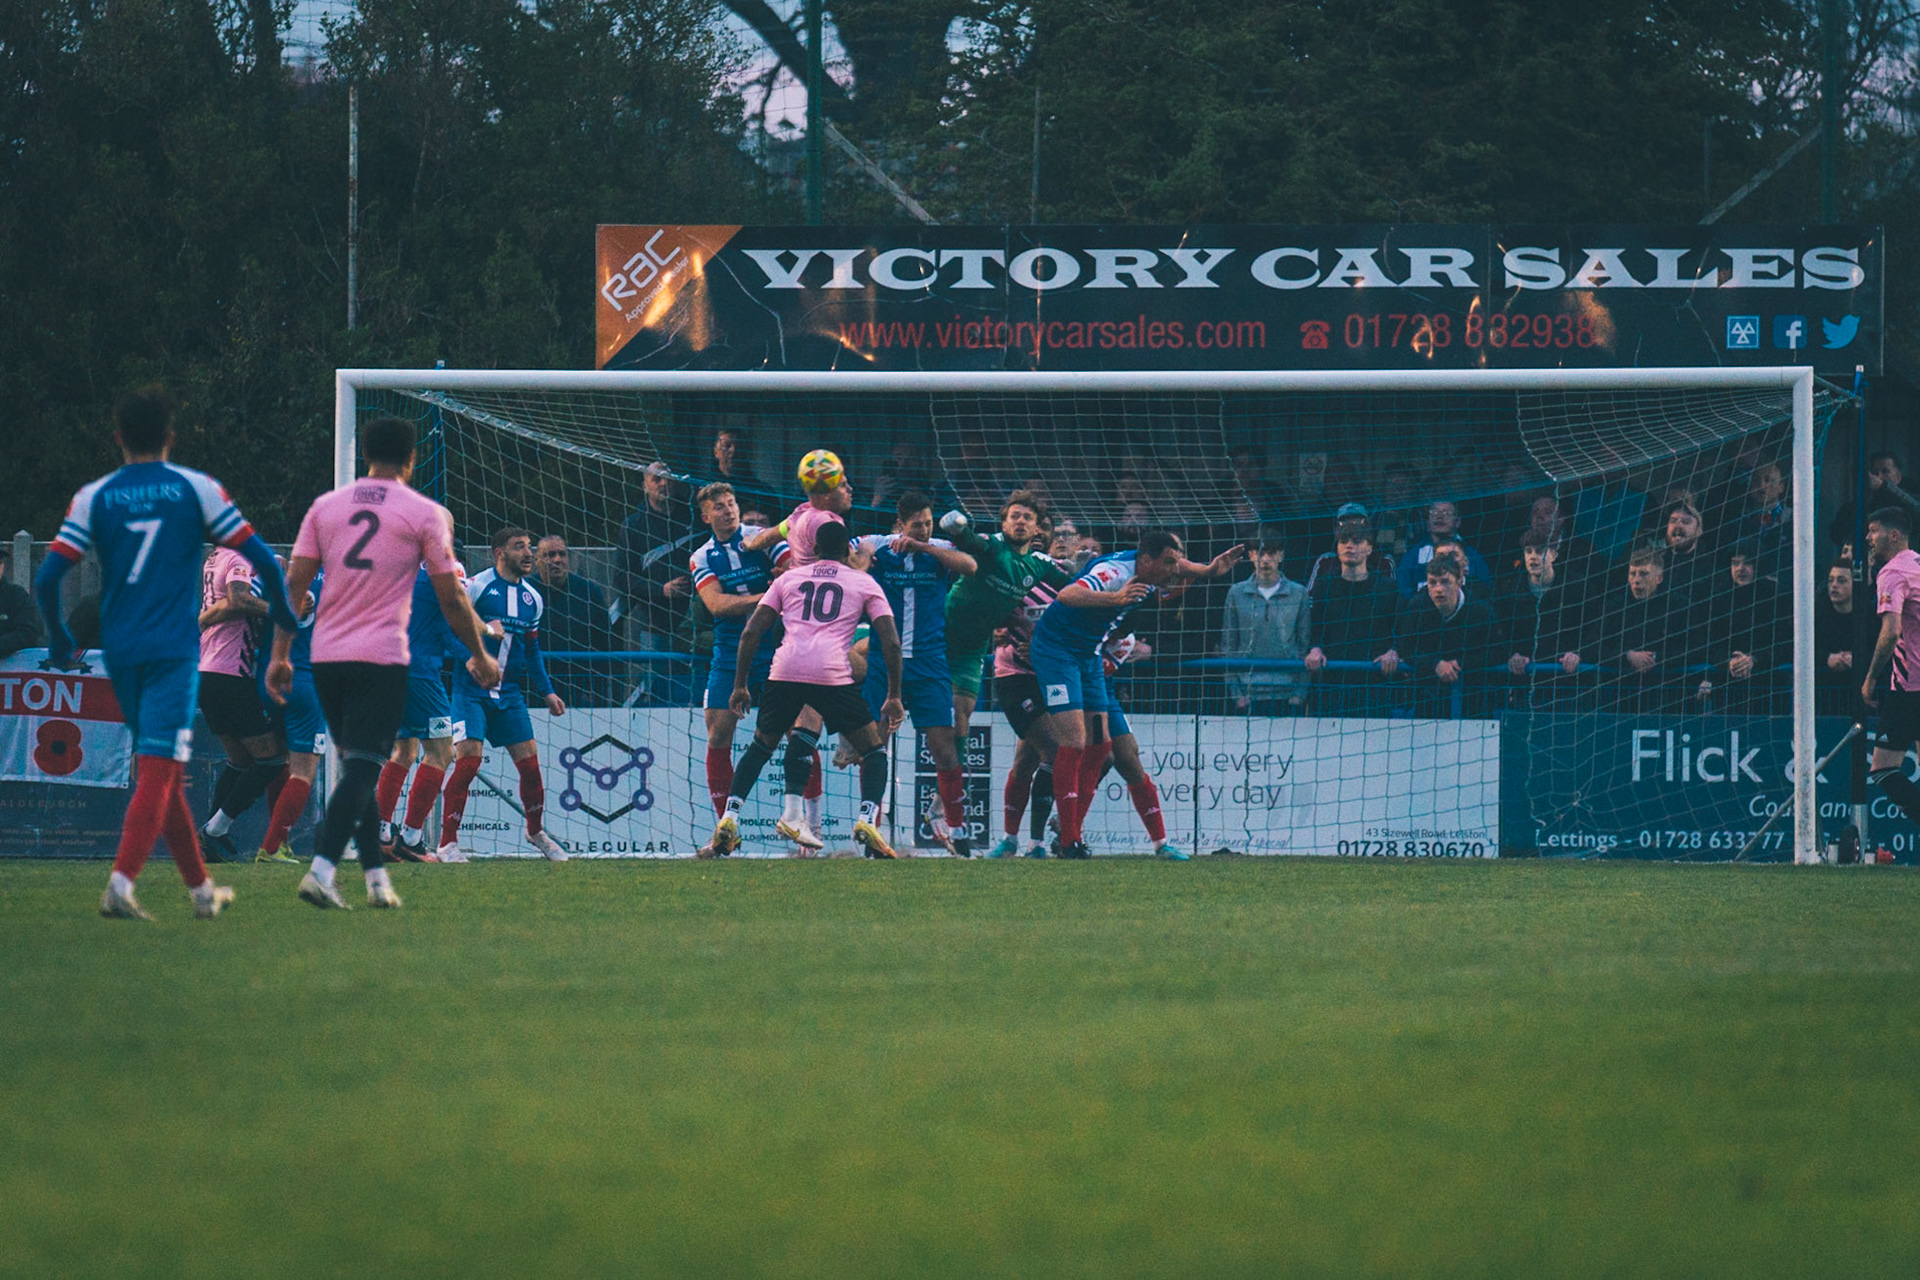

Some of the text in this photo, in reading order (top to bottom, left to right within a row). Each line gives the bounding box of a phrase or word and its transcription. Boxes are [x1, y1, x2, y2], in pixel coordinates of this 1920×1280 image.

[741, 247, 1866, 290] VICTORY CAR SALES
[839, 314, 1266, 356] www.victorycarsales.com
[1344, 313, 1451, 349] 01728
[125, 519, 162, 585] 7
[343, 510, 380, 571] 2
[798, 580, 844, 623] 10
[1153, 751, 1204, 776] you
[1214, 752, 1293, 780] every
[1632, 729, 1763, 782] Flick
[1159, 783, 1224, 810] very
[1232, 784, 1282, 811] day
[1337, 840, 1484, 858] 01728 830670
[1366, 828, 1379, 837] 43
[1381, 828, 1420, 838] Sizewell
[1535, 829, 1618, 853] Lettings
[1639, 830, 1702, 849] 01728
